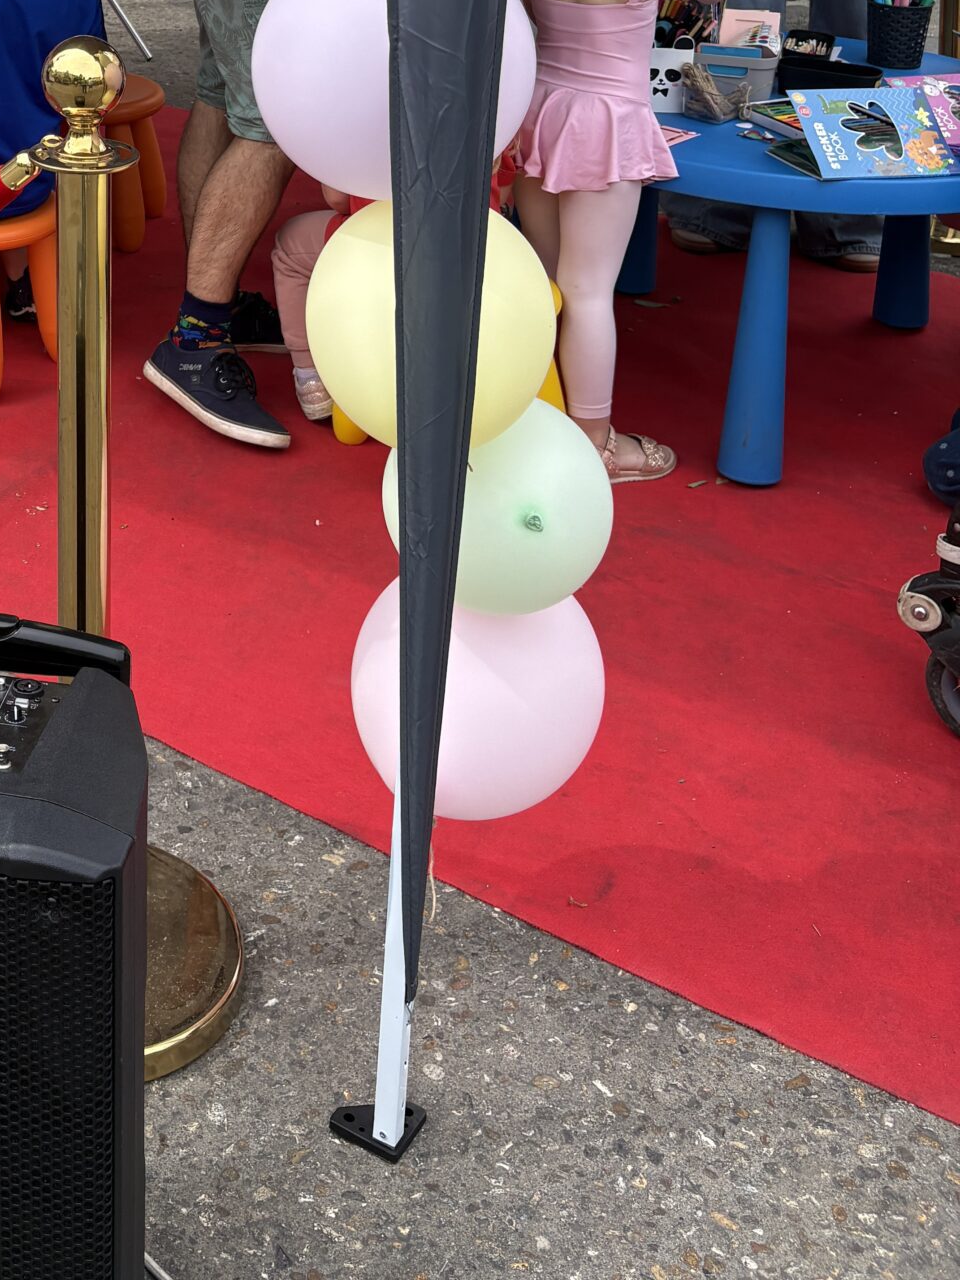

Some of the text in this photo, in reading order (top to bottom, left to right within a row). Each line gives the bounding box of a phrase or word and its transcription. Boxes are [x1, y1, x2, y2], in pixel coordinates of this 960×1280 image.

[935, 106, 958, 130] BOOK
[813, 122, 841, 170] STICKER
[828, 131, 849, 161] BOOK
